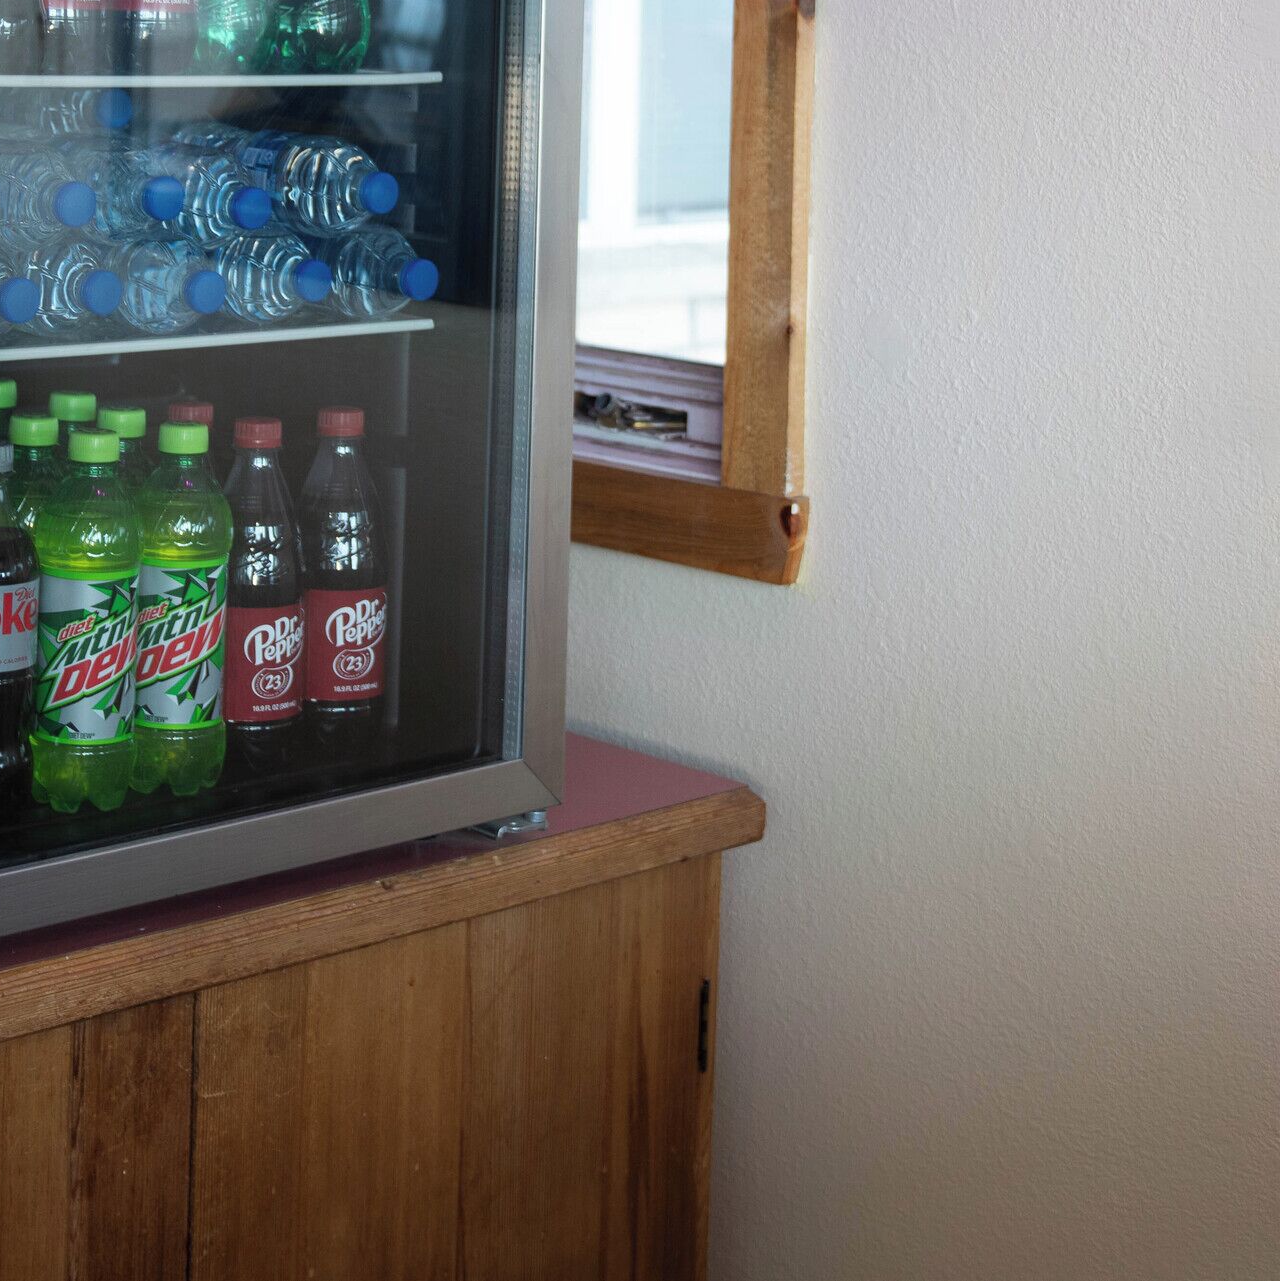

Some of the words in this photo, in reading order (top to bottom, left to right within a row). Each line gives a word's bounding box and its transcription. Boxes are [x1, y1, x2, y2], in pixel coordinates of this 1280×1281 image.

[138, 602, 168, 624] diet
[355, 599, 380, 624] Dr
[59, 616, 95, 642] diet
[274, 616, 298, 640] Dr
[345, 655, 363, 672] 23
[265, 674, 282, 690] 23
